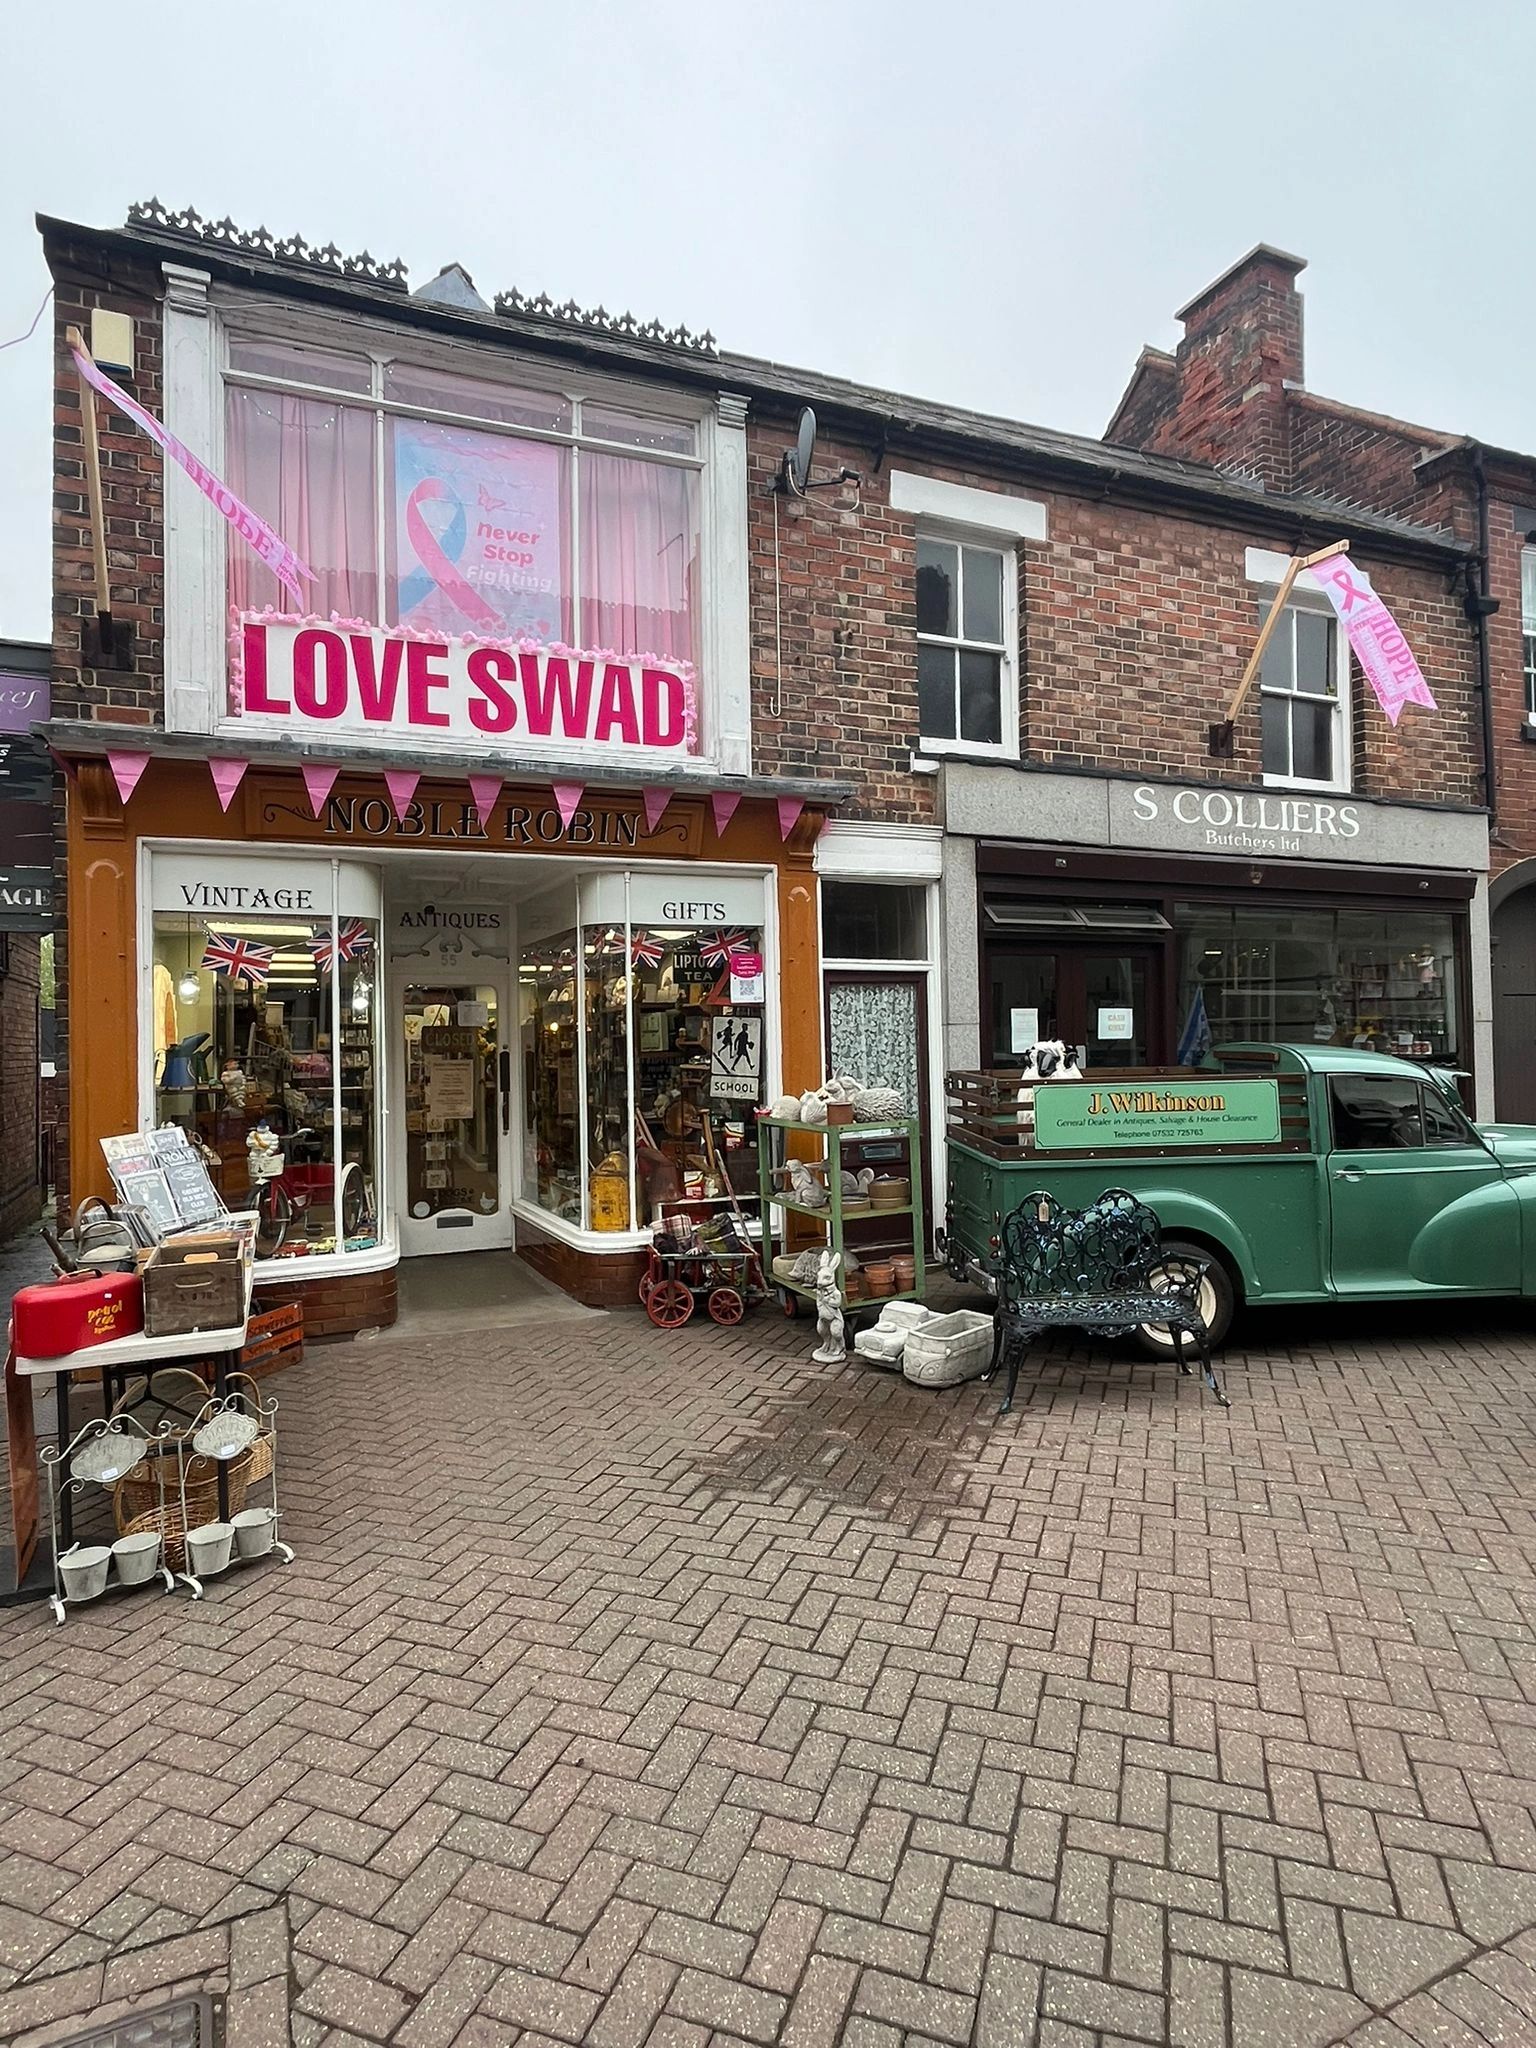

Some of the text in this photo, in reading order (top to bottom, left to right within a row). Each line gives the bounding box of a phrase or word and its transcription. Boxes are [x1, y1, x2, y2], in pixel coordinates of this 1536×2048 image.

[484, 544, 534, 568] Stop
[467, 564, 553, 592] Fighting
[1371, 615, 1420, 685] HOPE
[243, 623, 686, 747] LOVE SWAD
[324, 797, 641, 847] NOBLE ROBIN
[1133, 786, 1360, 837] S COLLIERS
[1206, 829, 1300, 851] Butchers ltd
[180, 882, 313, 909] VINTAGE
[400, 911, 500, 929] ANTIQUES
[663, 902, 726, 920] GIFTS
[441, 954, 457, 967] 55
[684, 971, 713, 981] TEA
[425, 1032, 475, 1046] CLOSED
[714, 1081, 754, 1093] SCHOOL
[1056, 1118, 1086, 1127] General
[1087, 1118, 1111, 1126] Dealer
[1113, 1117, 1121, 1125] in
[1159, 1116, 1187, 1125] Salvage
[1196, 1115, 1220, 1124] House
[1222, 1114, 1259, 1123] Clearance
[1113, 1130, 1150, 1139] Telephone
[87, 1300, 122, 1323] petrol
